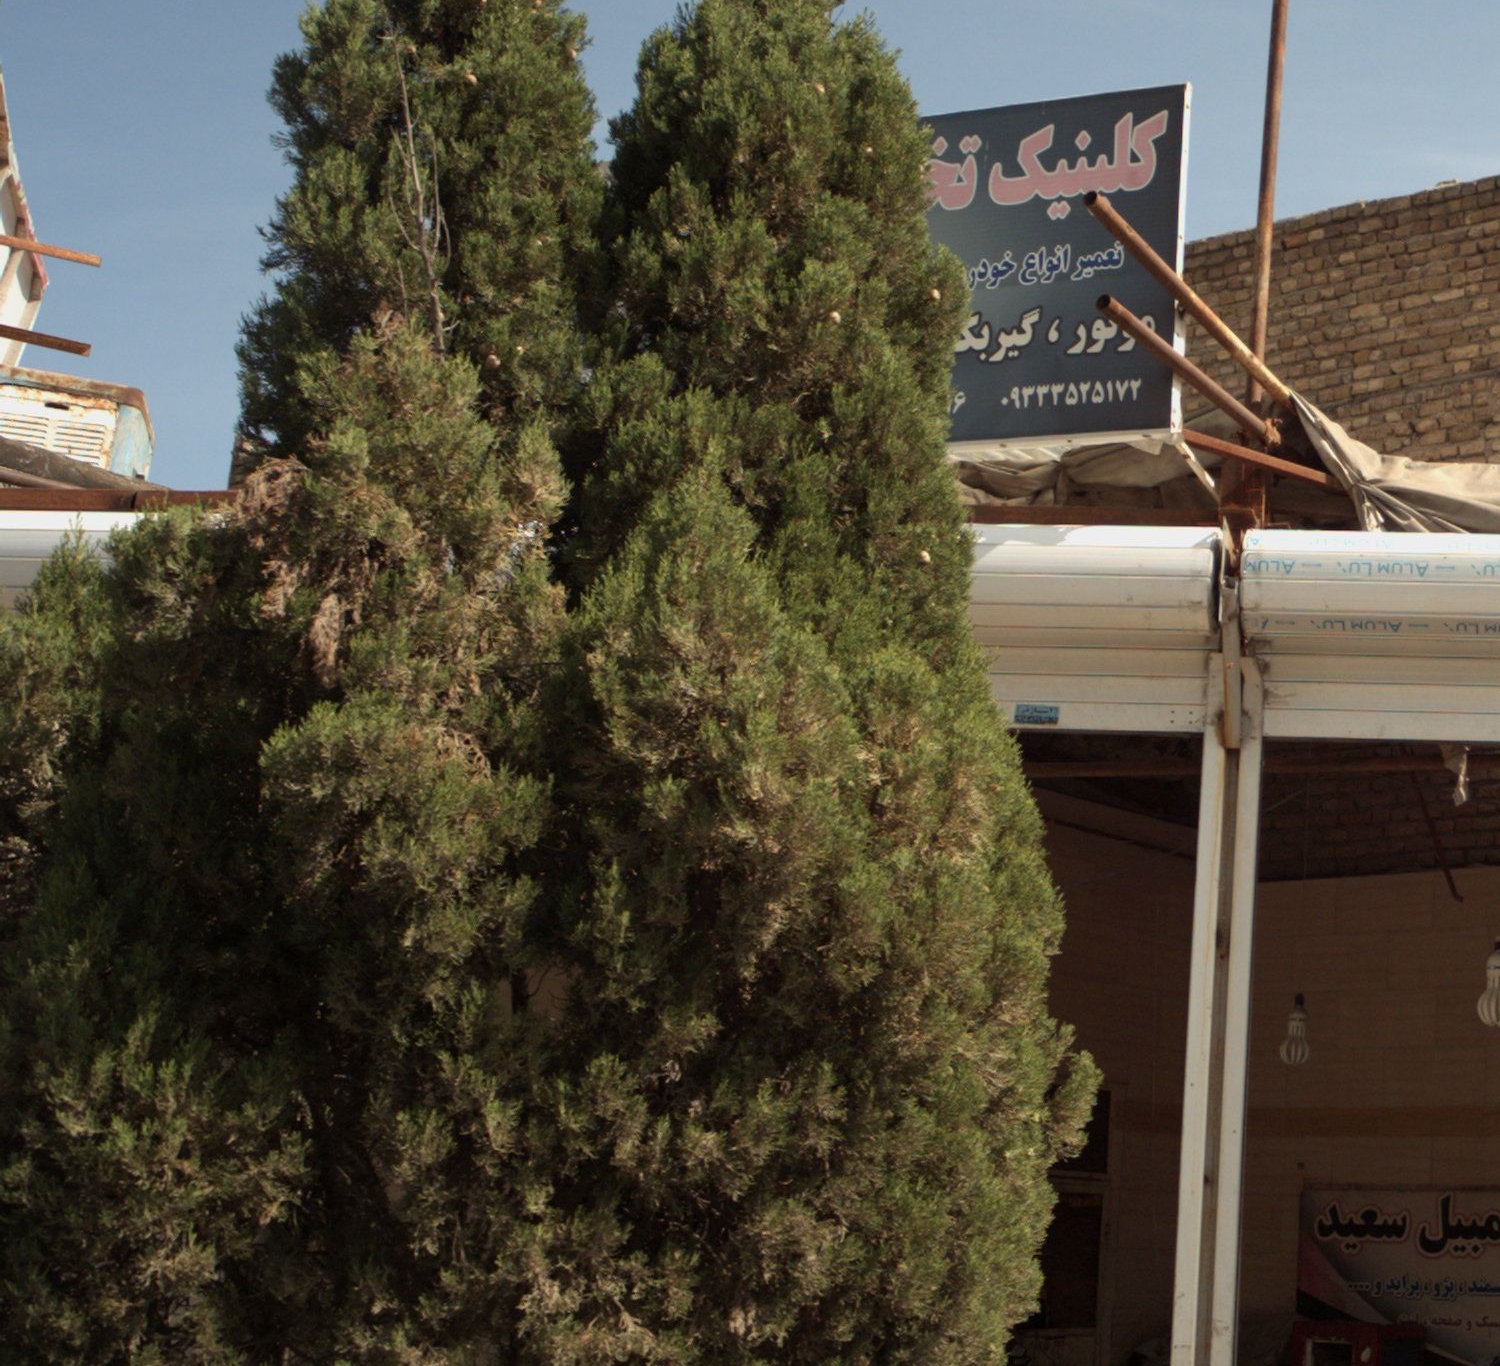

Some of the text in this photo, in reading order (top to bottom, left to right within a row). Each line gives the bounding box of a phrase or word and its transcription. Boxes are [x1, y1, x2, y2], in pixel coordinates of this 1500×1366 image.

[969, 241, 1126, 291] تعمیر انواع خودر
[1316, 1204, 1407, 1250] سعید
[1373, 1280, 1382, 1296] و
